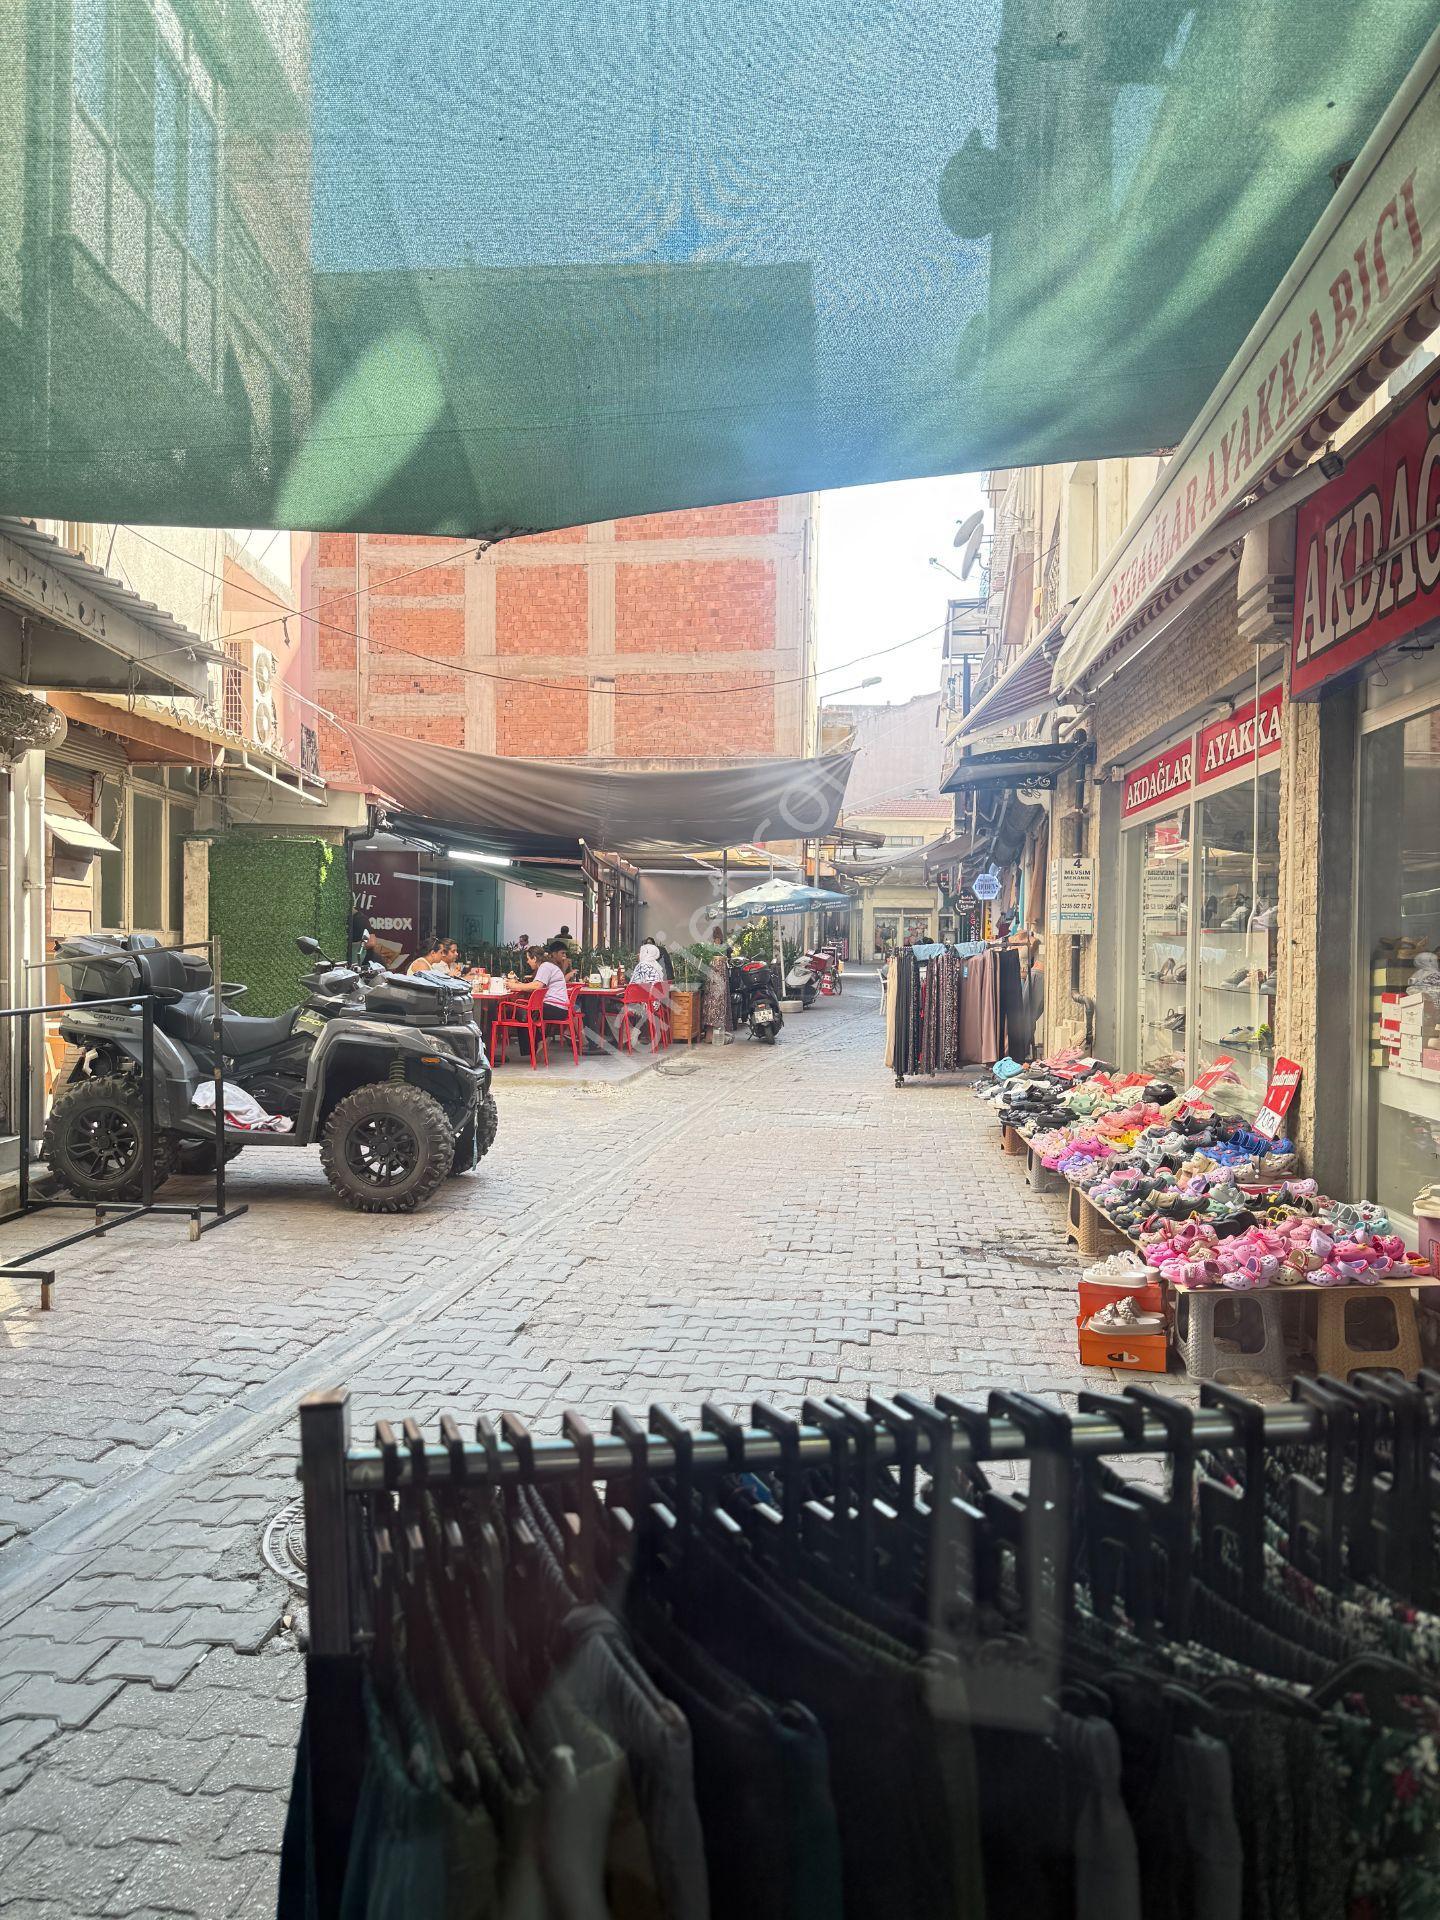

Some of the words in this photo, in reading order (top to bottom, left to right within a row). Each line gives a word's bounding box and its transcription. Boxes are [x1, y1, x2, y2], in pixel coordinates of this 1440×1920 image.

[1126, 753, 1191, 810] AKDAĞLAR
[1204, 705, 1282, 773] AYAKKA
[354, 872, 381, 886] TARZ
